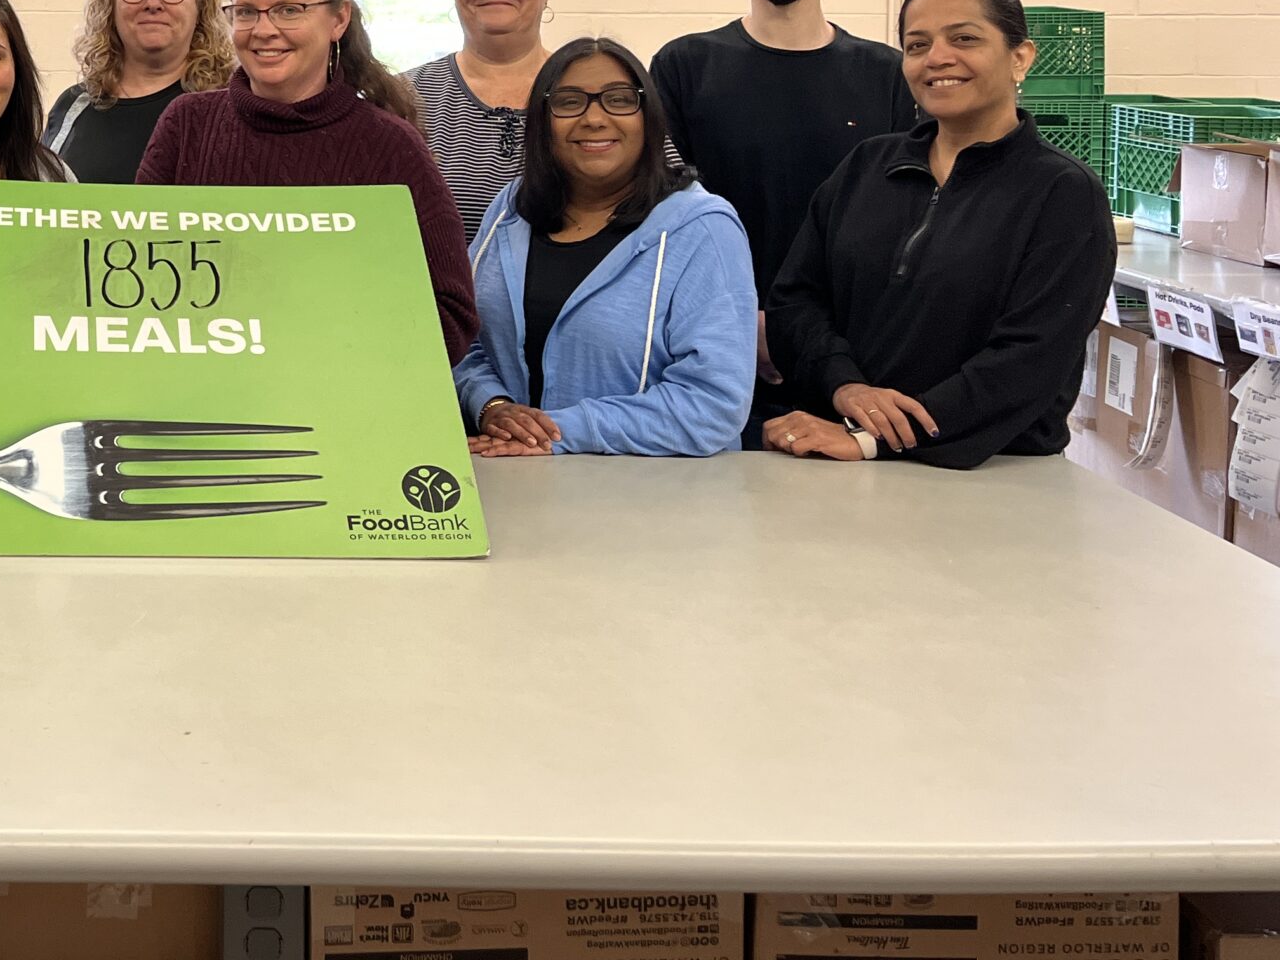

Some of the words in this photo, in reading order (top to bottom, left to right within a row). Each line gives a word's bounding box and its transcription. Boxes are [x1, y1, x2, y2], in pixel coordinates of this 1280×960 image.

[110, 210, 169, 231] WE
[179, 212, 356, 232] PROVIDED
[82, 238, 221, 311] 1855
[1155, 291, 1167, 302] Hot
[1250, 311, 1262, 323] Dry
[32, 315, 265, 355] MEALS!
[347, 514, 469, 531] FoodBank
[334, 894, 379, 909] Zehrs
[413, 891, 450, 903] YNCU
[565, 894, 719, 913] thefoodbank.ca
[567, 914, 628, 925] #FeedWR
[1015, 916, 1074, 927] #FeedWR
[359, 934, 389, 943] Here's
[998, 943, 1056, 954] REGION
[1061, 942, 1145, 954] WATERLOO
[1151, 942, 1170, 952] OF
